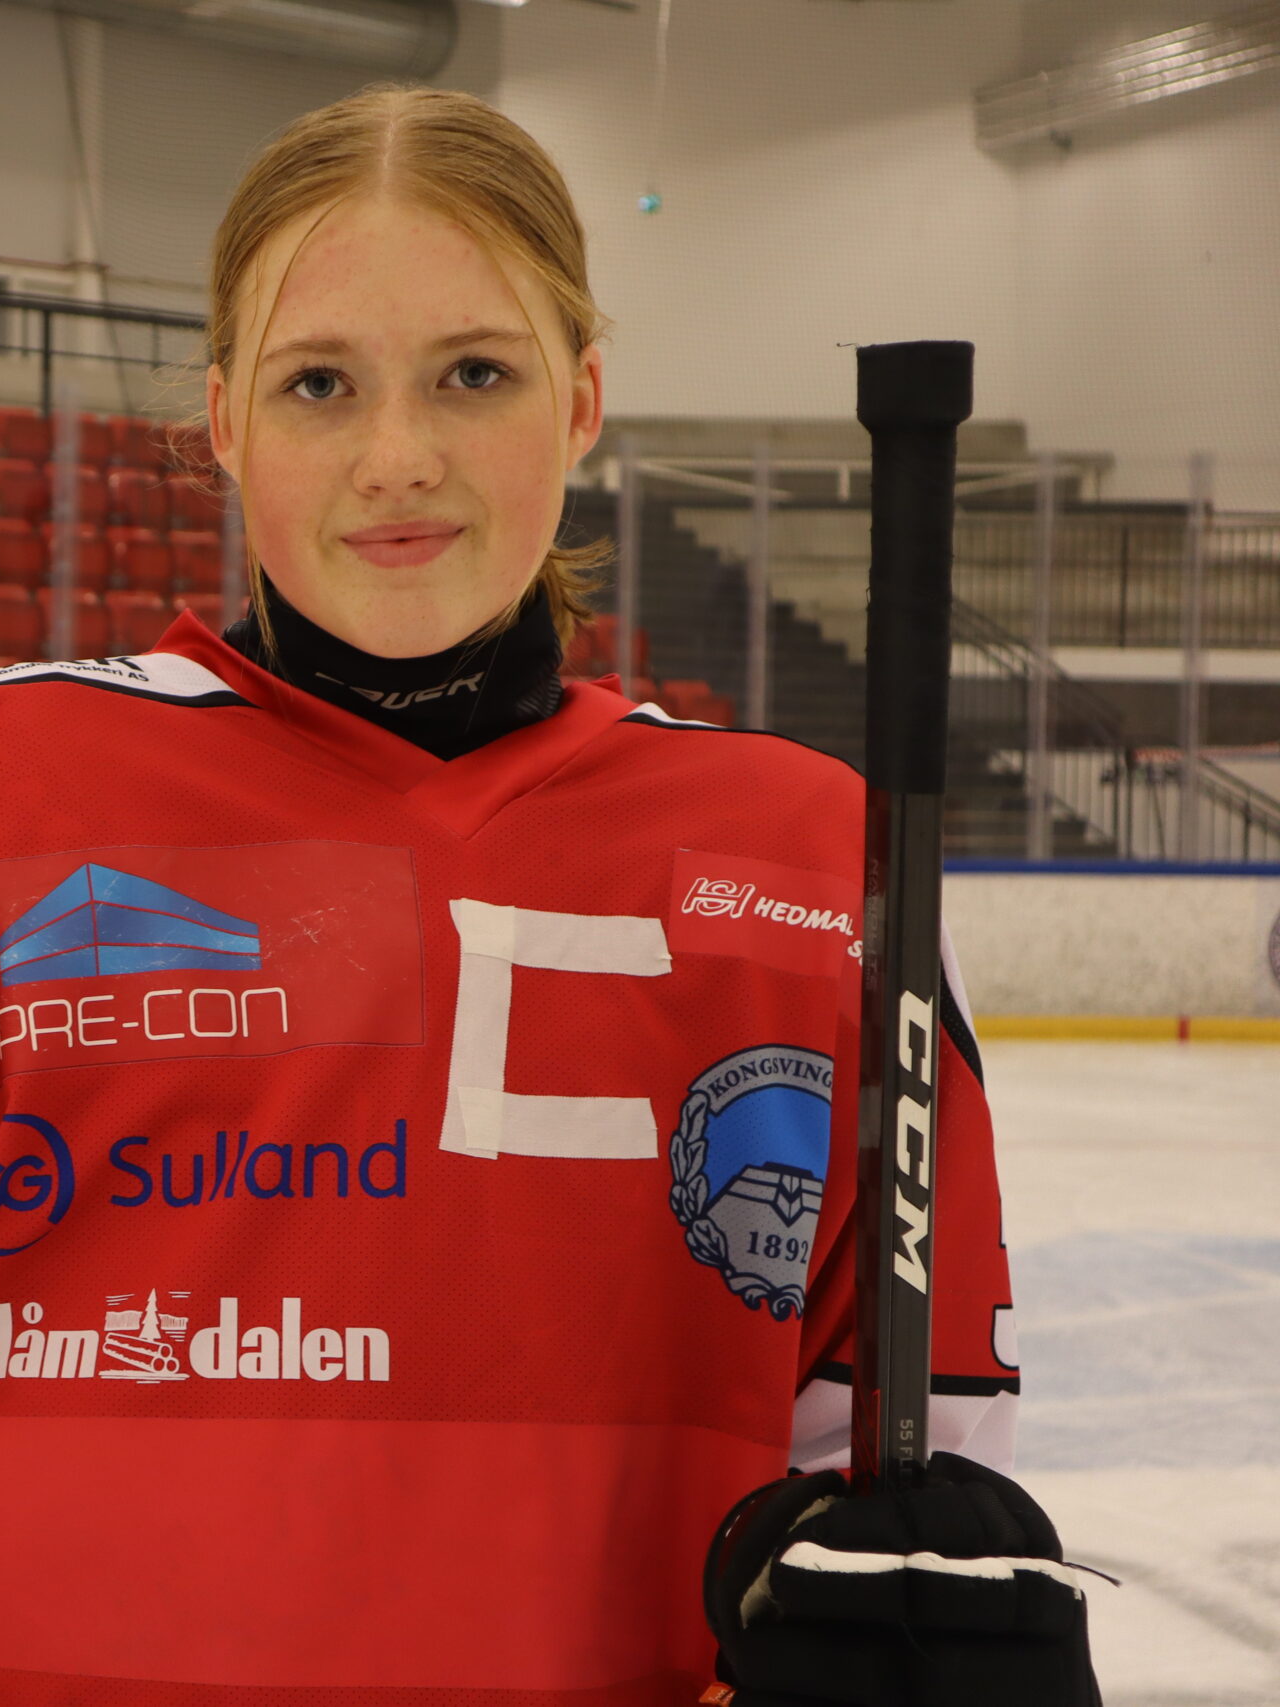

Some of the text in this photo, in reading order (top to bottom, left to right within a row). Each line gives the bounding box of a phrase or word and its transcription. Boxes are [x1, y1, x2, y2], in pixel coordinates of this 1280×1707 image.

[128, 671, 150, 682] AS
[894, 990, 934, 1295] CCM
[108, 1118, 407, 1208] Sulland
[746, 1231, 809, 1265] 1892
[900, 1418, 914, 1440] 55
